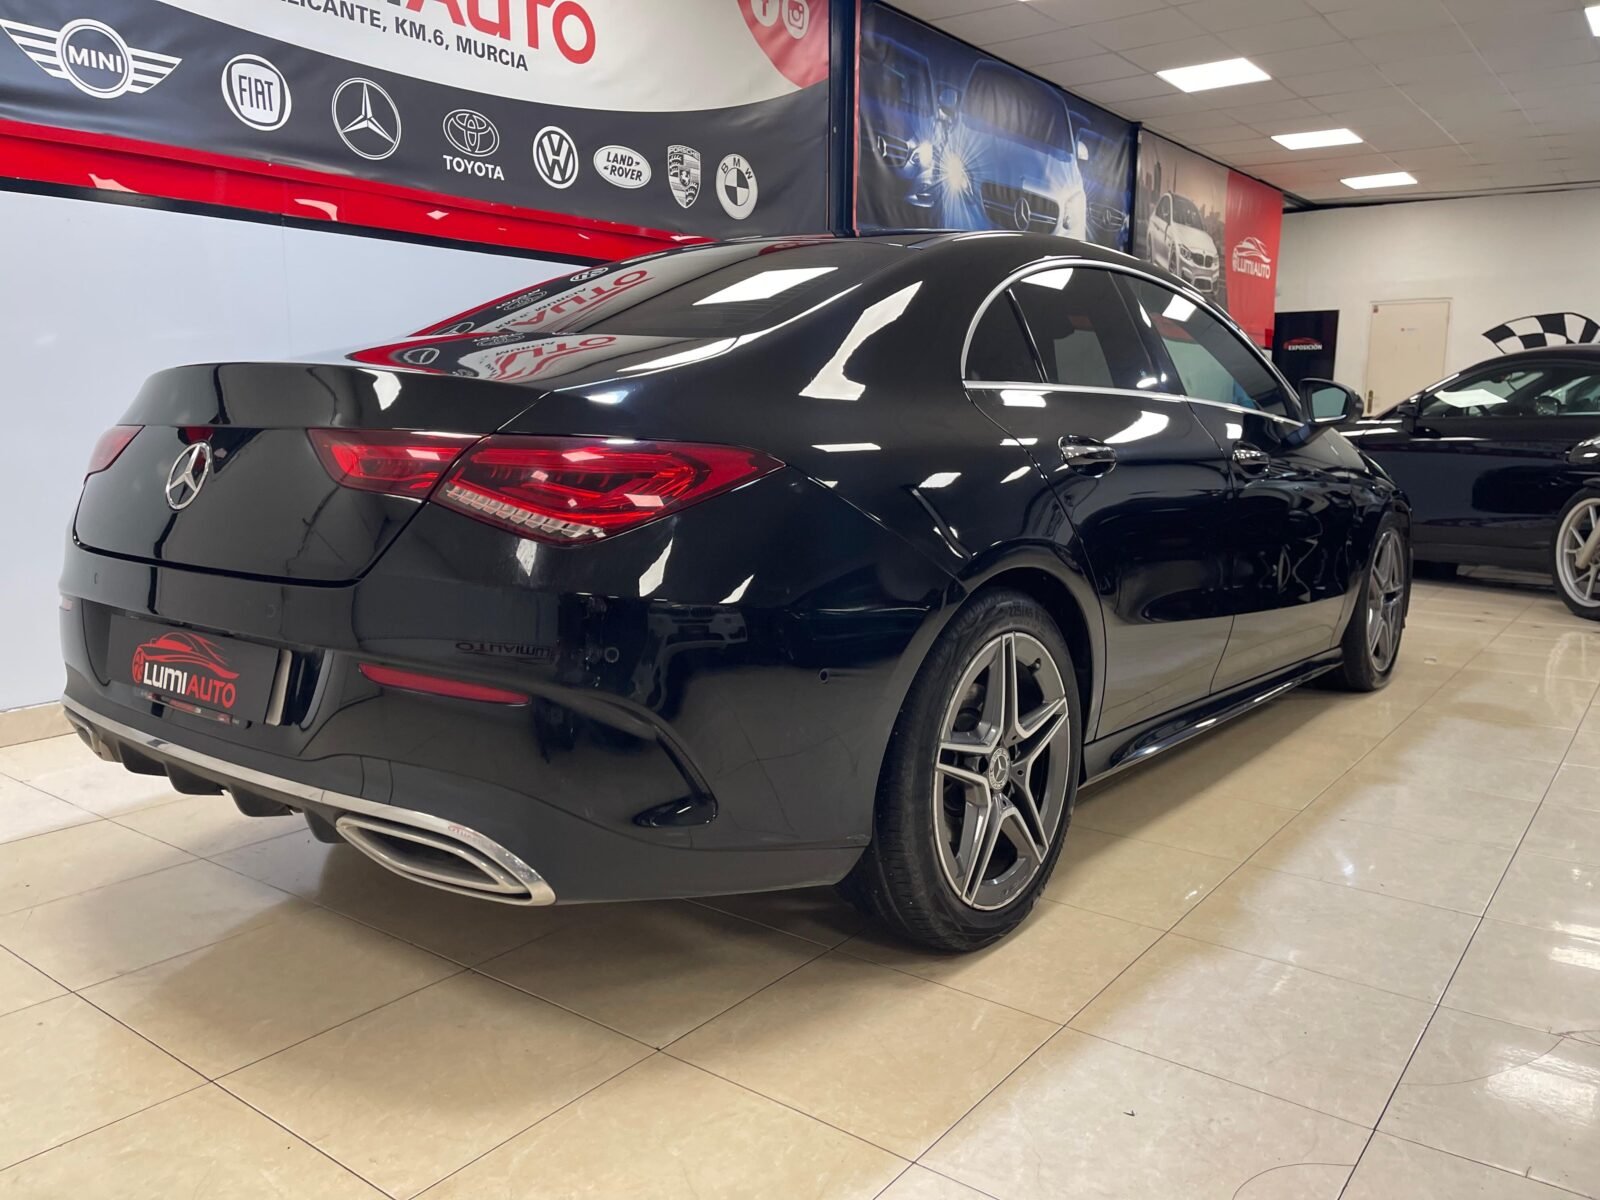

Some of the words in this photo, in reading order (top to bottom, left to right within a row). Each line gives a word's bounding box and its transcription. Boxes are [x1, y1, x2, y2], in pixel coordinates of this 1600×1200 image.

[281, 0, 387, 32] CANTE,
[394, 16, 450, 51] KM.6,
[456, 35, 529, 72] MURCIA
[67, 45, 123, 74] MINI
[238, 74, 274, 112] FIAT
[442, 155, 505, 181] TOYOTA
[609, 165, 643, 182] ROVER
[720, 157, 754, 181] BMW
[1237, 256, 1271, 280] LUMIAUTO
[143, 662, 236, 708] LUMIAUTO
